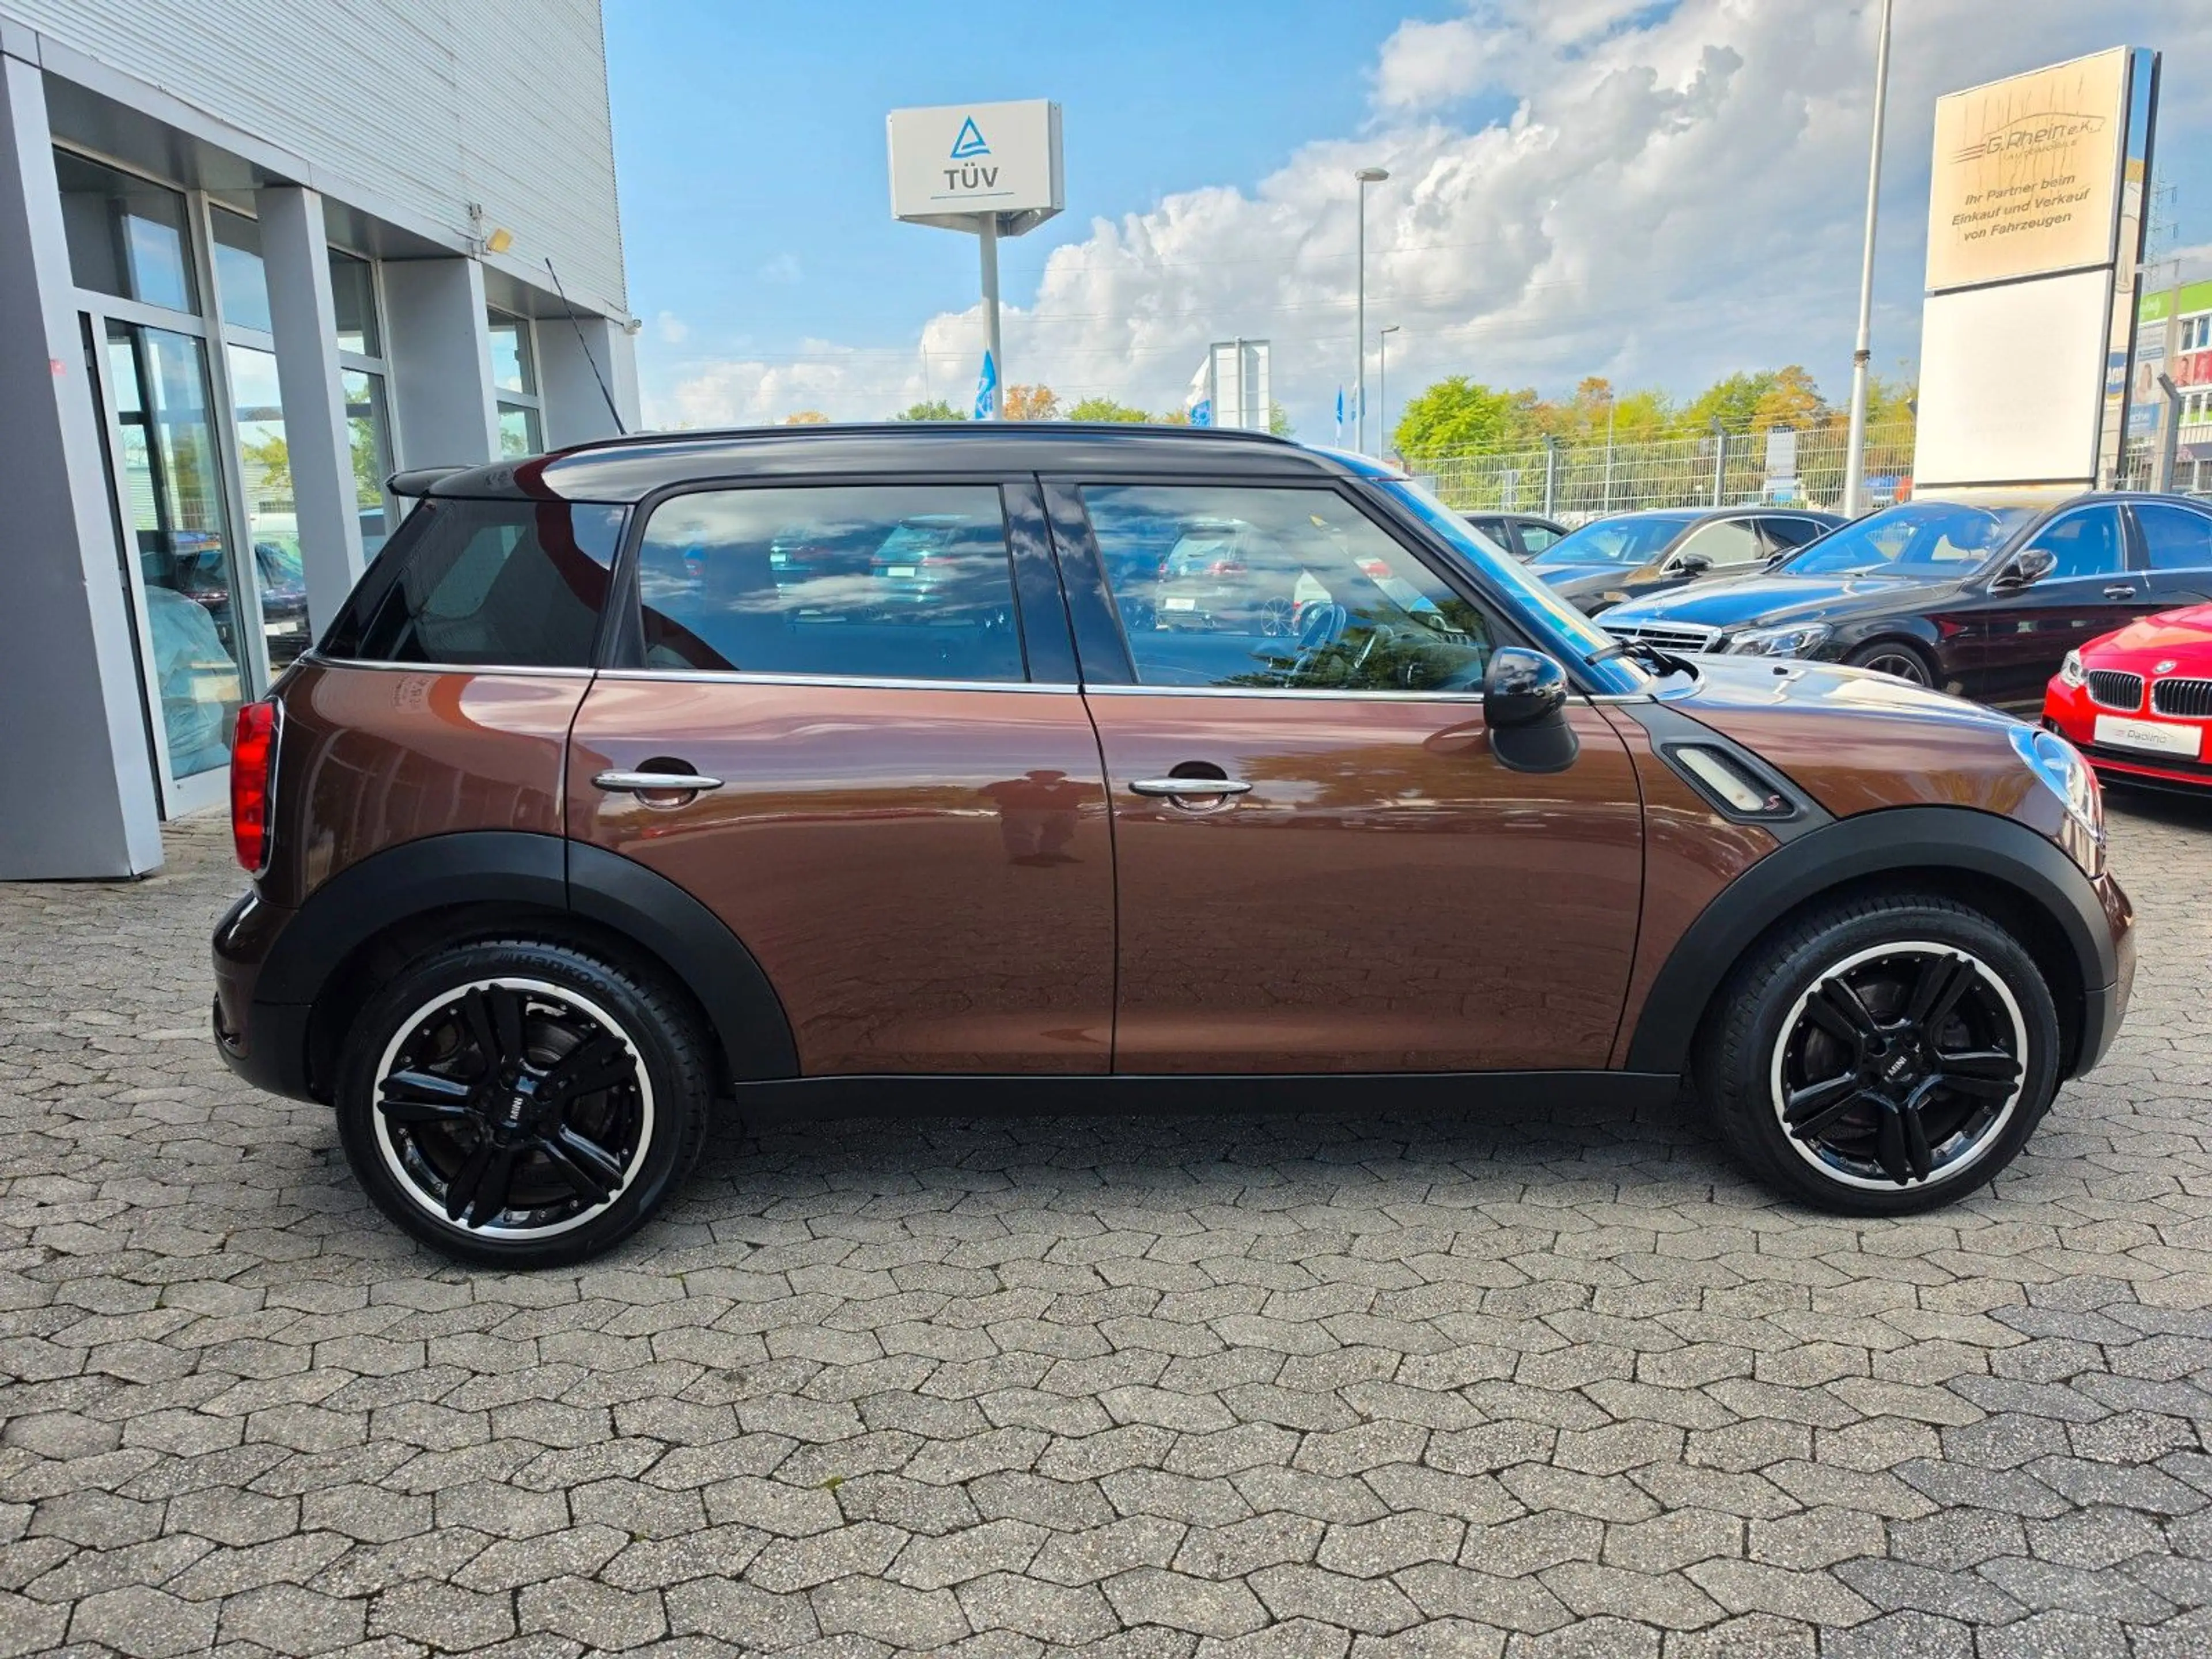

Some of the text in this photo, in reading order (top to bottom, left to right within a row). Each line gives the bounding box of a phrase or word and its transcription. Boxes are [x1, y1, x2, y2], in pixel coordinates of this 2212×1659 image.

[944, 162, 999, 190] TÜV
[1965, 175, 2076, 206] Ihr Partner beim
[1952, 188, 2091, 226] Einkauf und Verkauf
[1964, 213, 2072, 241] von Fahrzeugen
[1887, 1055, 1908, 1077] MINI
[509, 1097, 524, 1120] MINI
